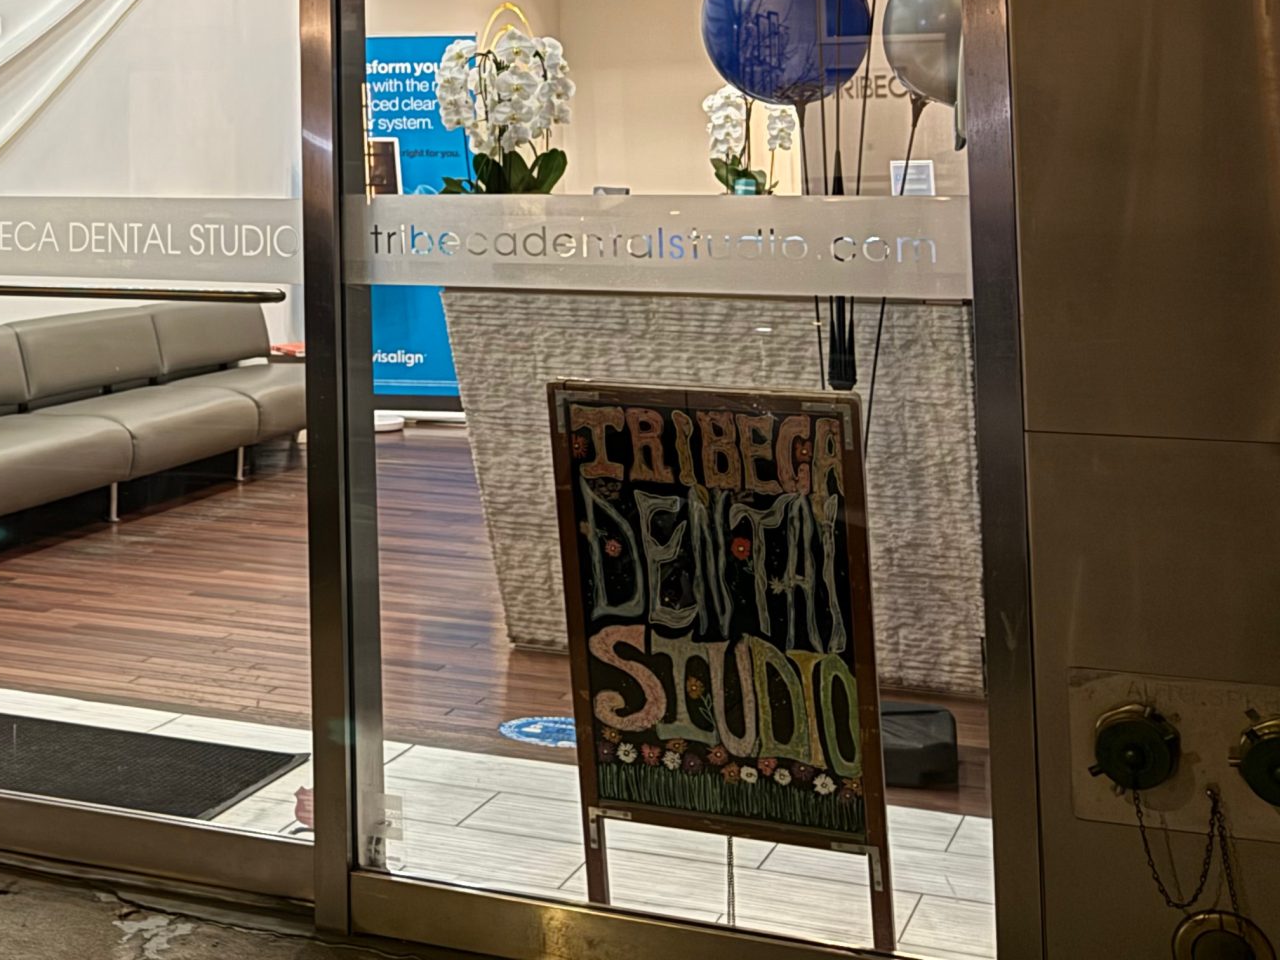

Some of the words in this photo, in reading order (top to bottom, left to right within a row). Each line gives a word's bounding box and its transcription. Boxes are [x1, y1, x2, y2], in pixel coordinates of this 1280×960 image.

[372, 79, 403, 92] with
[406, 78, 428, 92] the
[401, 97, 438, 111] clear
[378, 116, 434, 133] system.
[69, 221, 181, 255] DENTAL
[189, 224, 299, 258] STUDIO
[370, 223, 937, 264] tribecadentalstudio.com
[570, 404, 844, 497] TRIBECA
[588, 625, 863, 778] STUDIO
